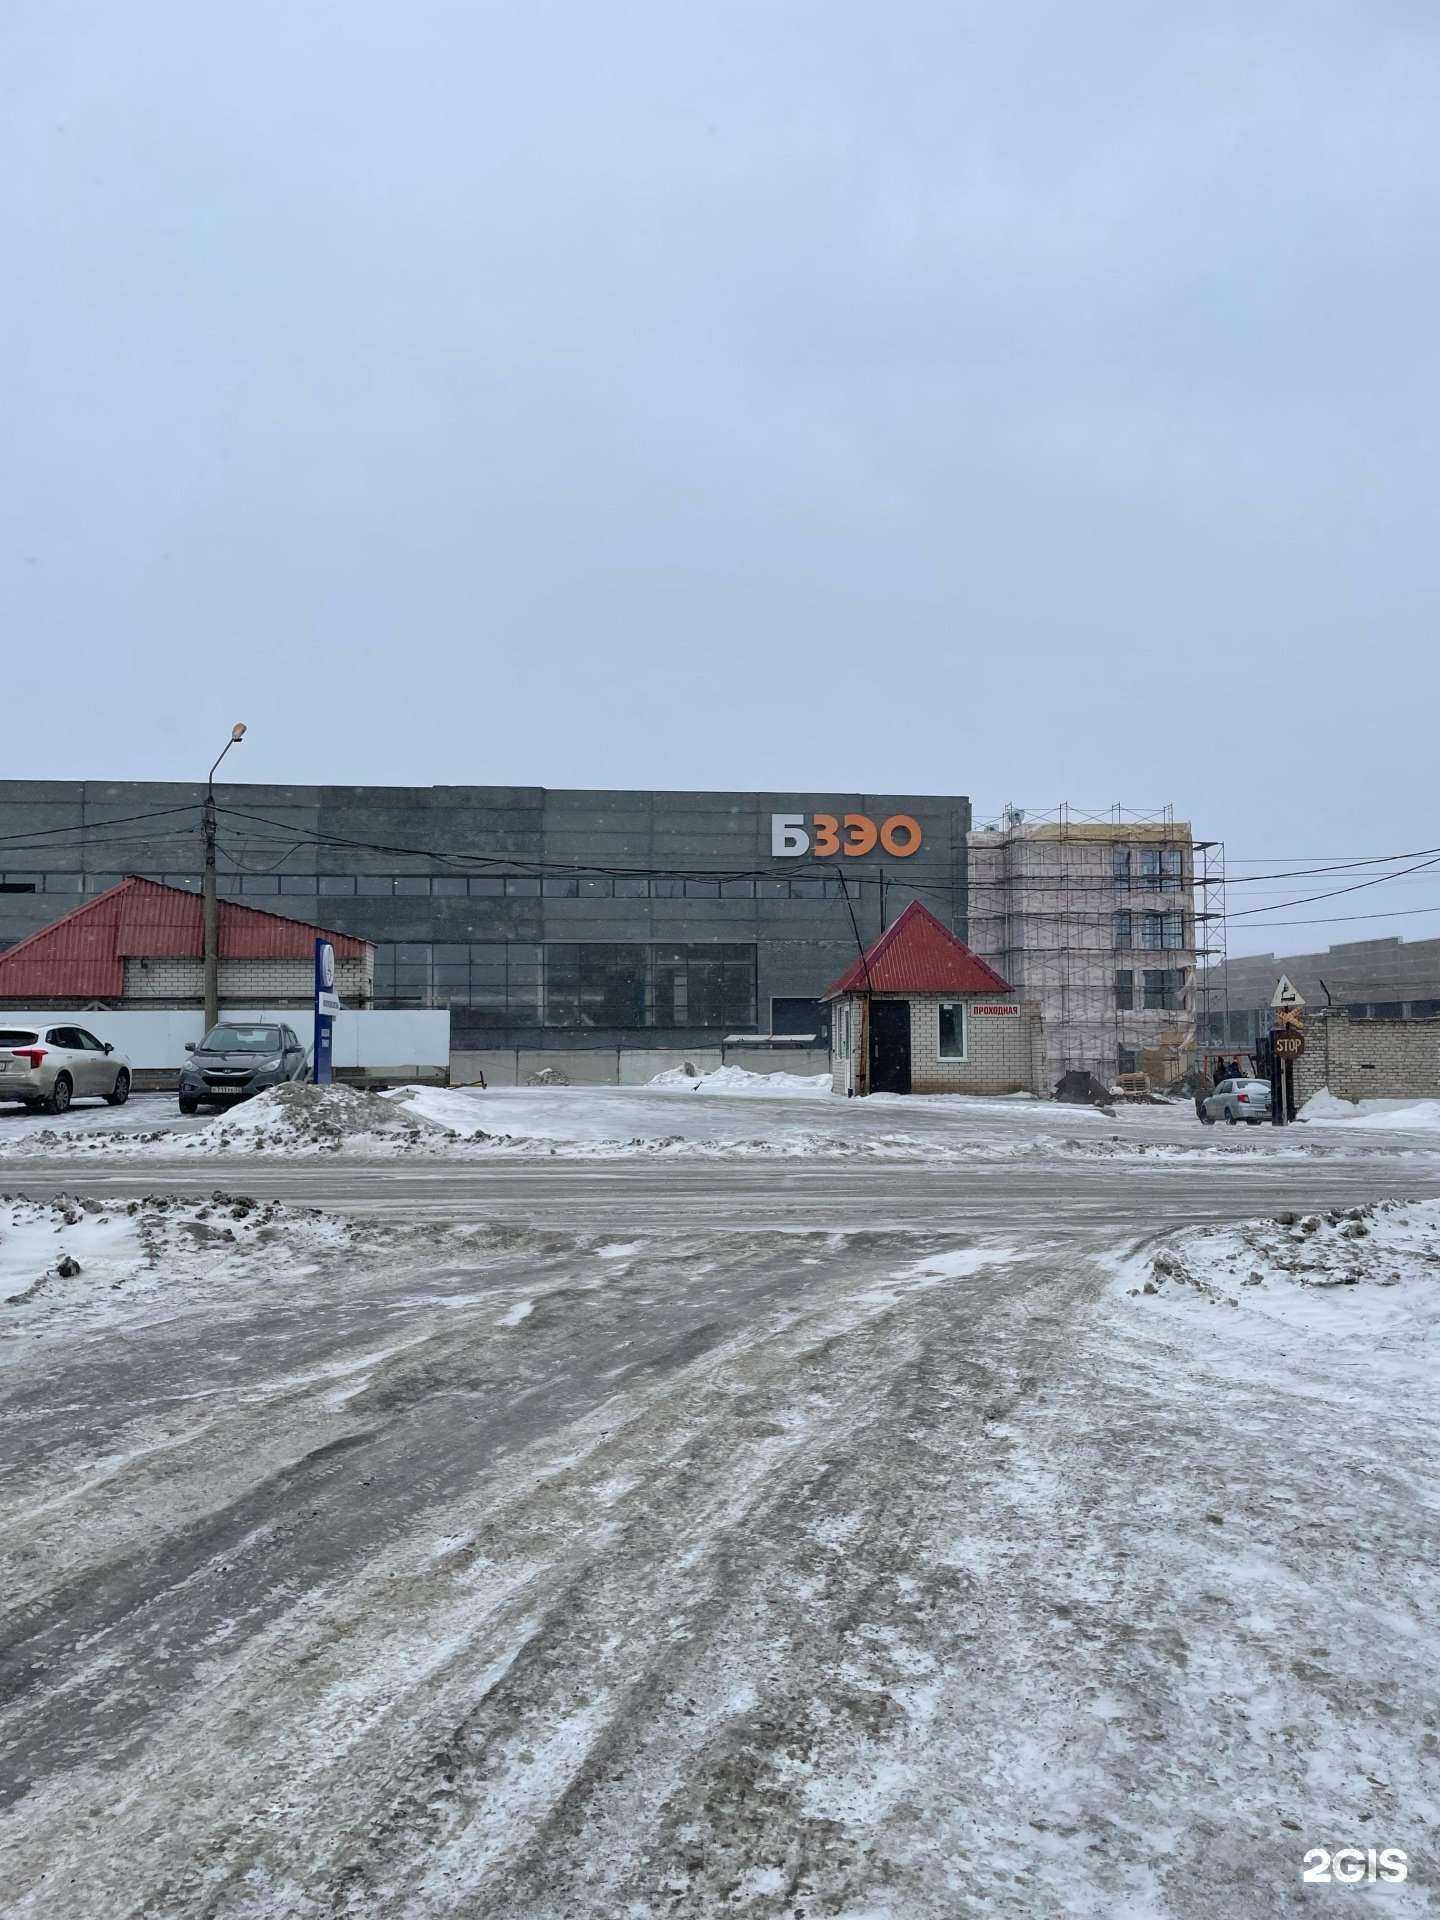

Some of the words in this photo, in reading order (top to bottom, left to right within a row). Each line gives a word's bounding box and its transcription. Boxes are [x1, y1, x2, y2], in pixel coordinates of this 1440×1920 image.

[772, 814, 921, 857] БЗЭО
[974, 1006, 1018, 1016] ПРОХОДНАЯ
[1276, 1038, 1302, 1053] STOP
